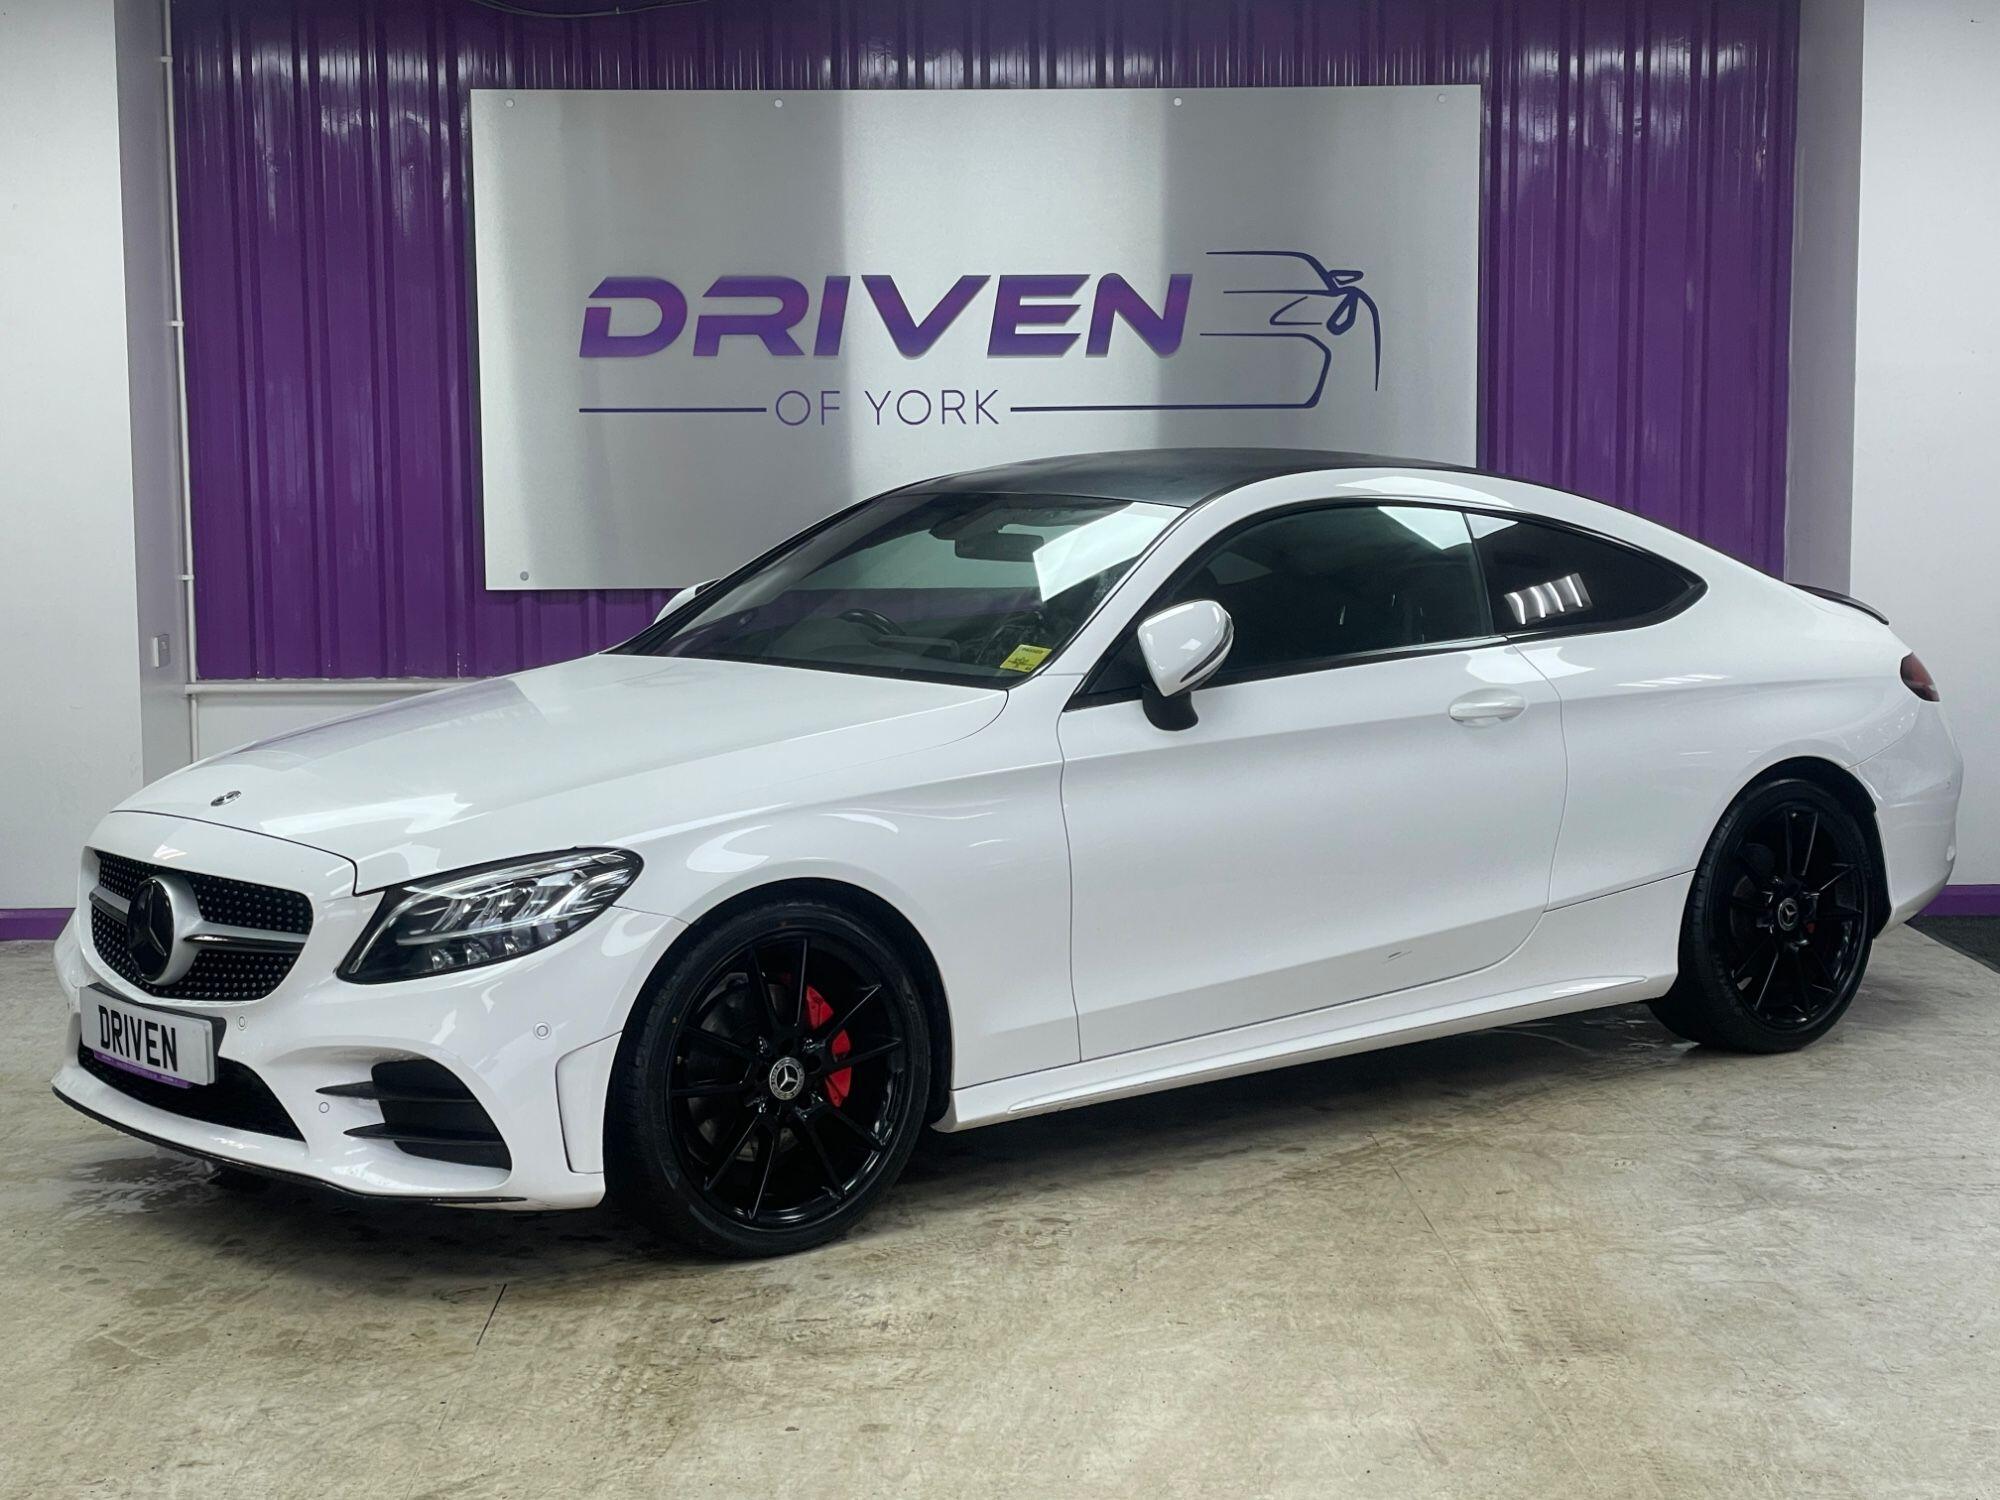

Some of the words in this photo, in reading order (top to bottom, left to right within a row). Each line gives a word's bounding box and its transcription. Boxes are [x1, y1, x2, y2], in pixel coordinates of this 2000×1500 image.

[579, 272, 1192, 359] DRIVEN
[775, 390, 842, 427] OF
[864, 389, 1000, 426] YORK
[98, 1004, 178, 1073] DRIVEN
